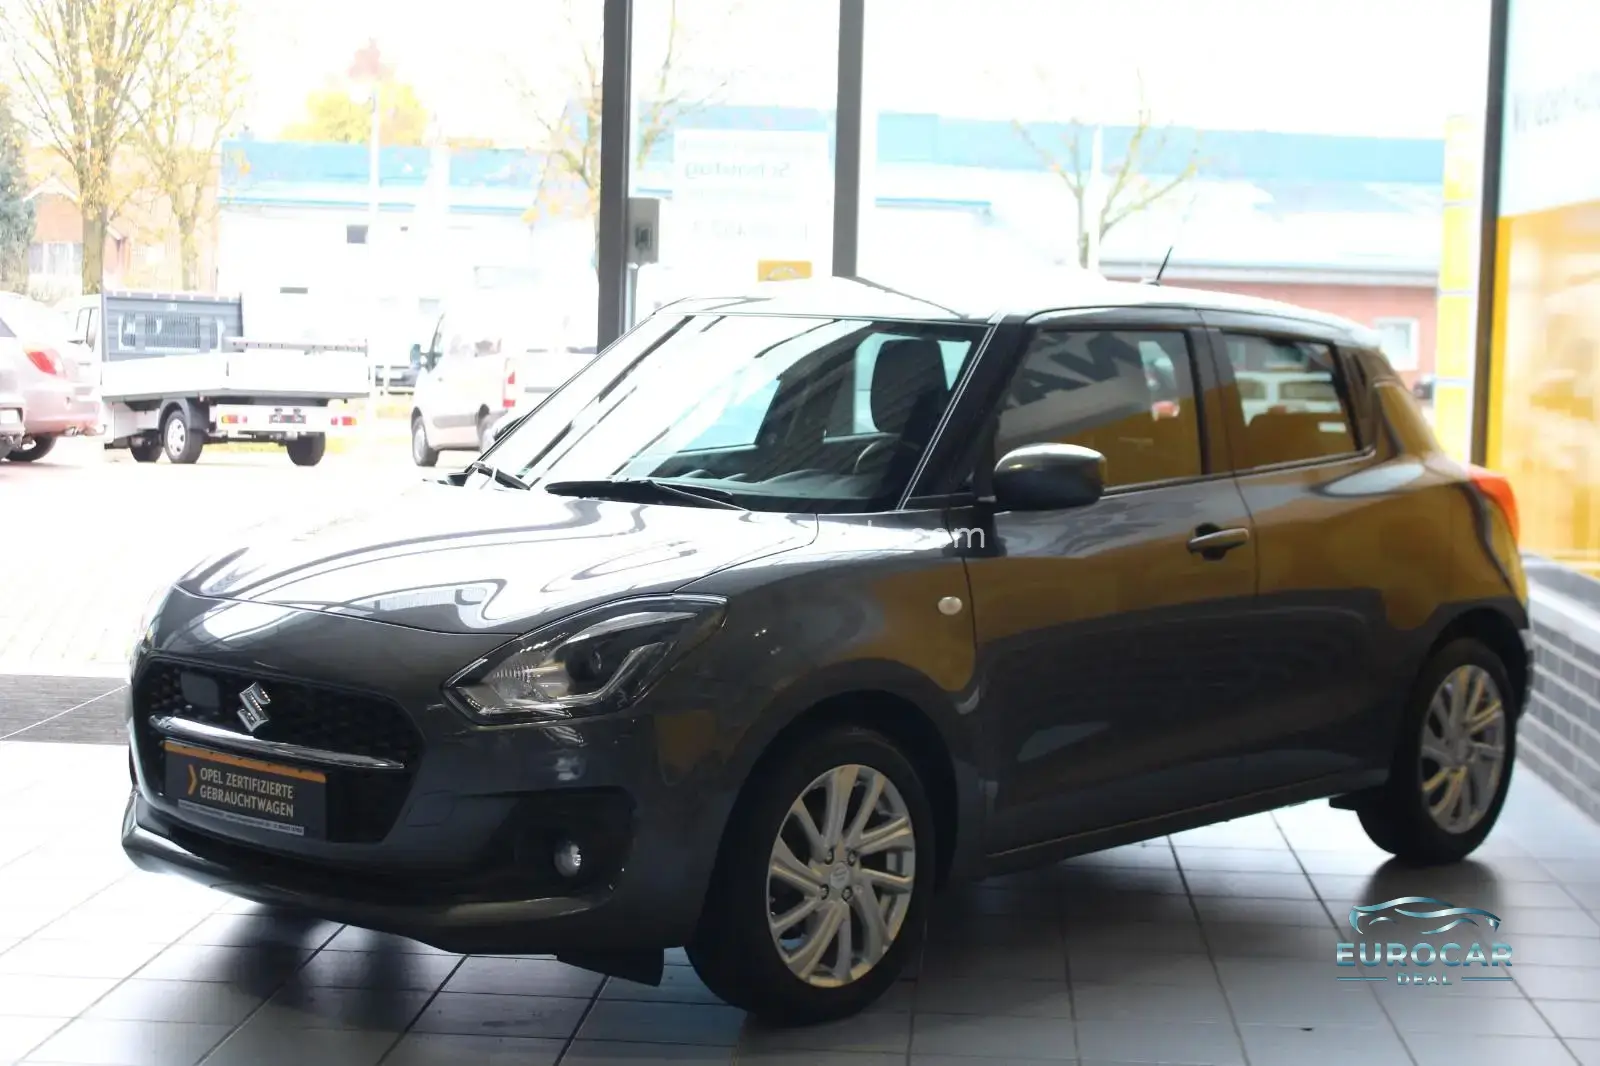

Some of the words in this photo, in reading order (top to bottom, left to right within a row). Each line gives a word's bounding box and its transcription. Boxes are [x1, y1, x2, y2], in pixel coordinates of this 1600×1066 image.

[200, 767, 223, 785] OPEL
[226, 772, 294, 799] ZERTIFIZIERTE
[200, 785, 294, 818] GEBRAUCHTWAGEN
